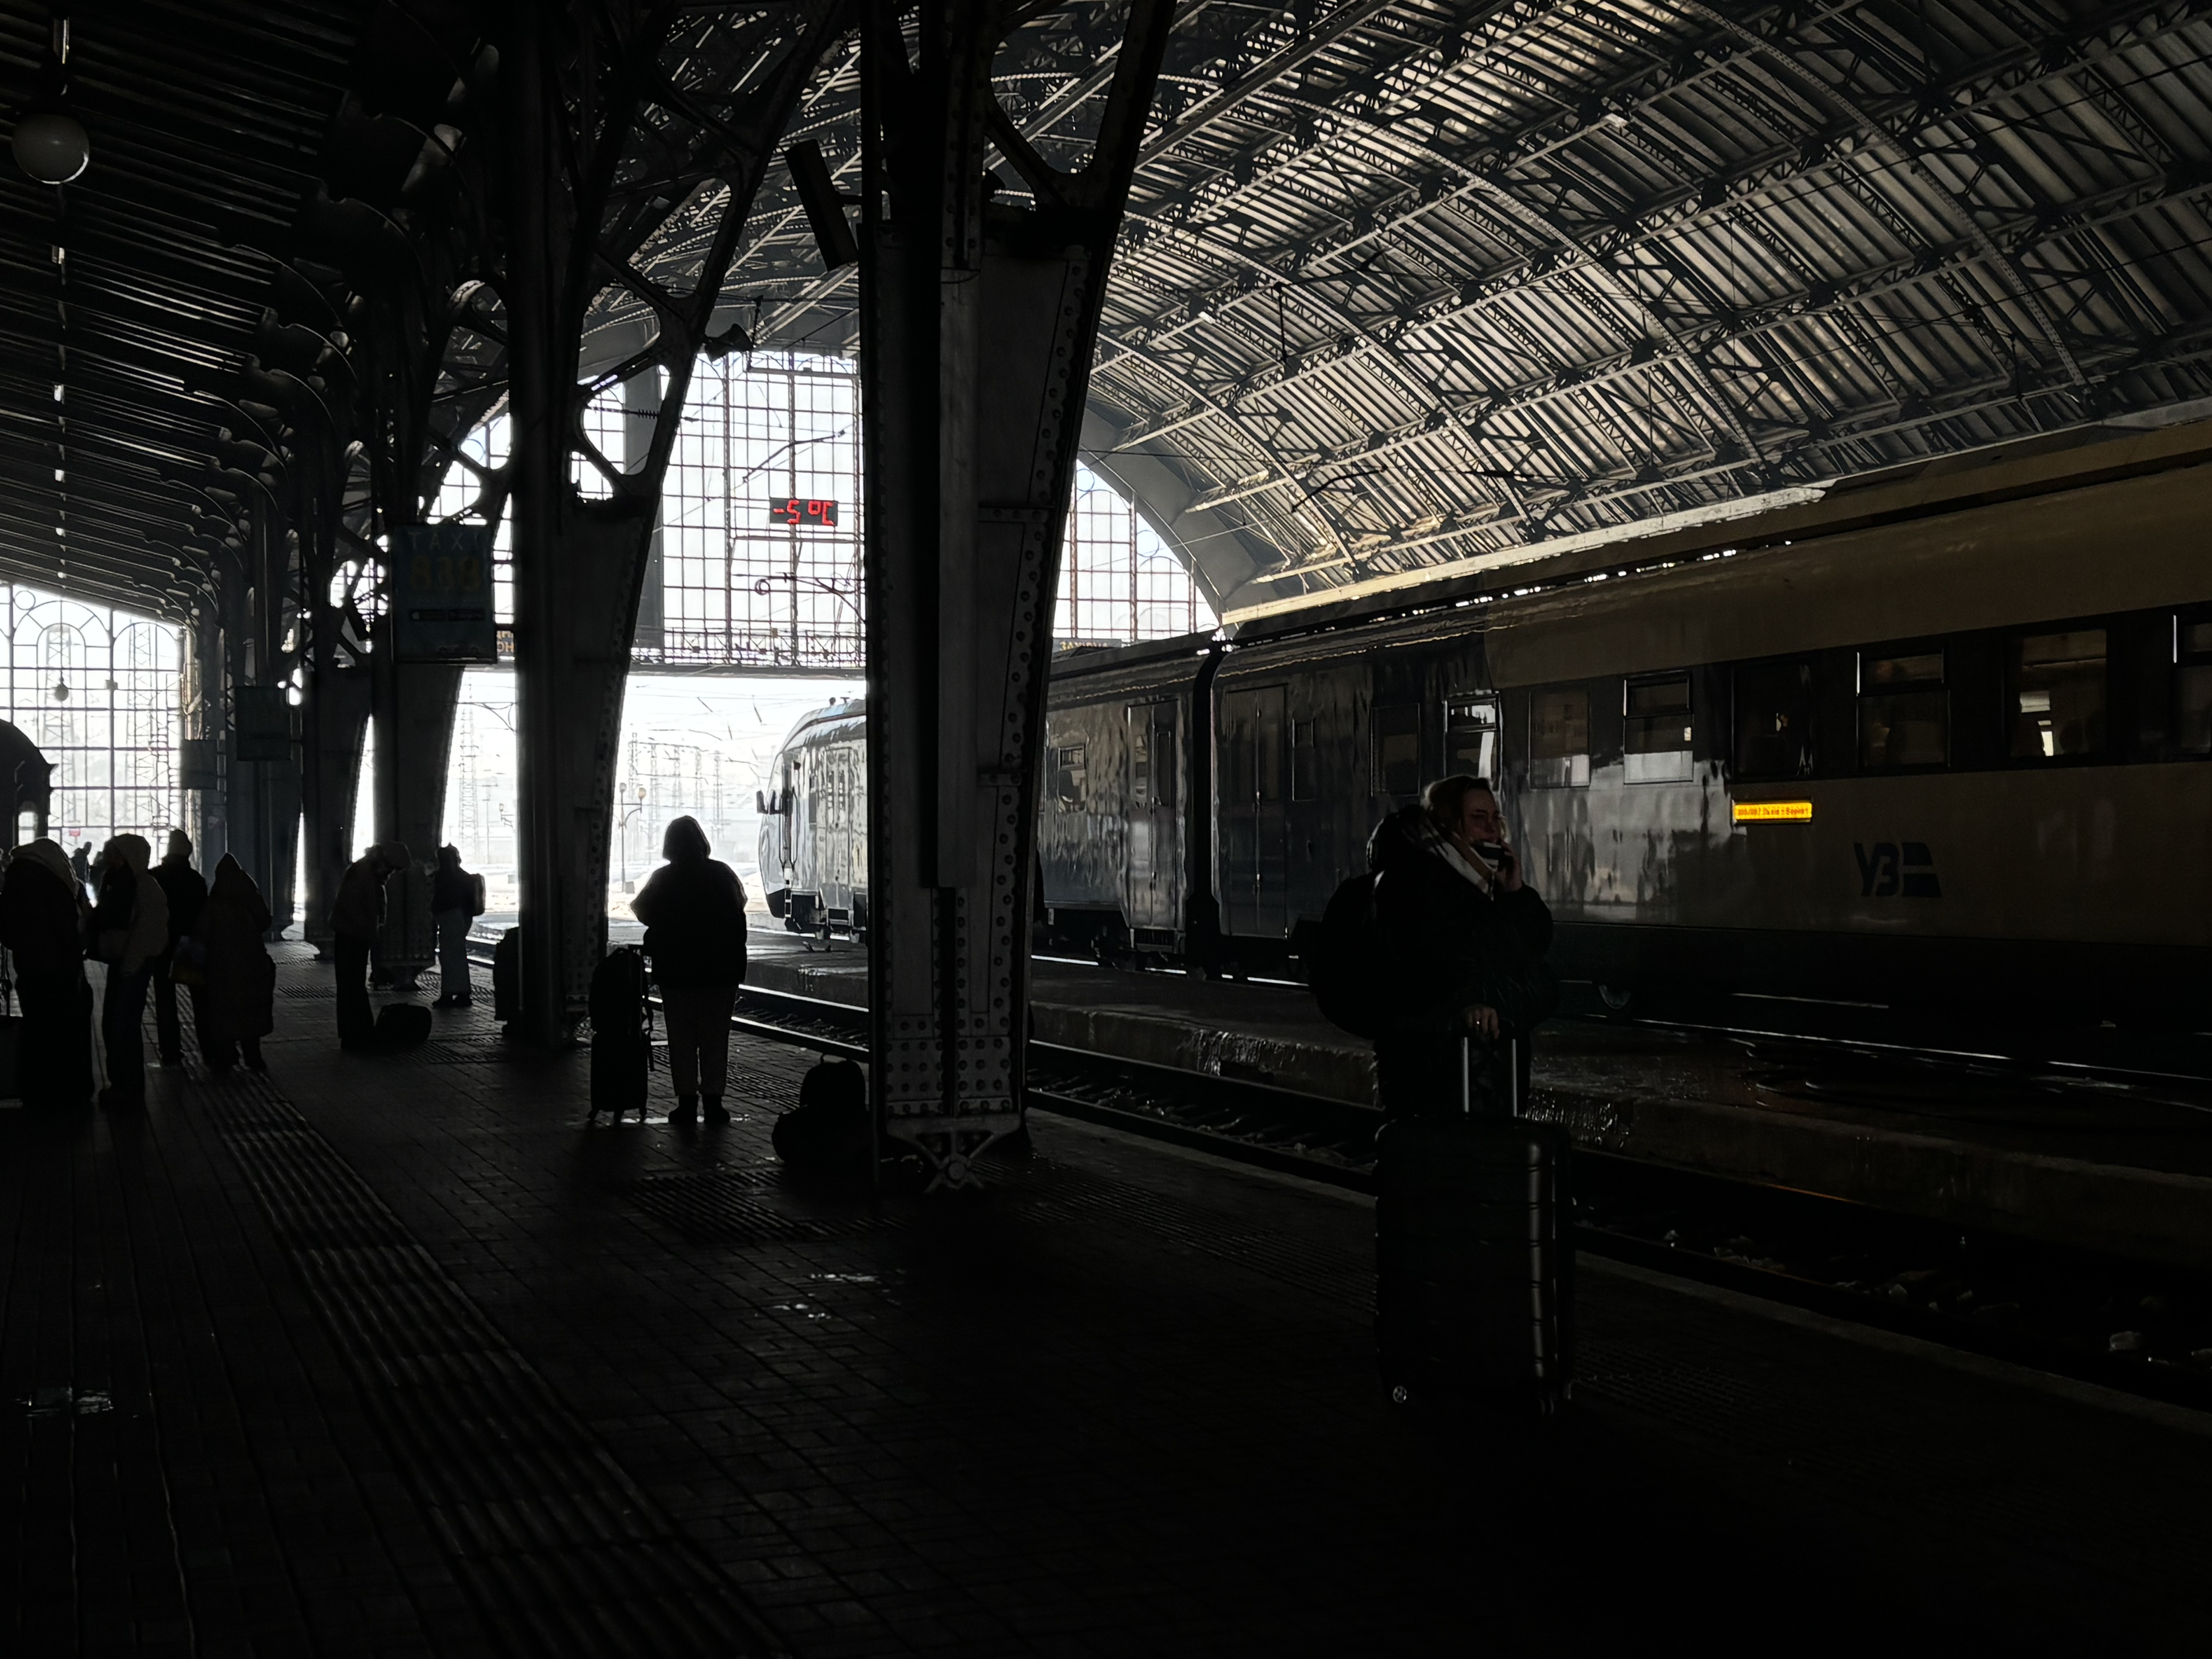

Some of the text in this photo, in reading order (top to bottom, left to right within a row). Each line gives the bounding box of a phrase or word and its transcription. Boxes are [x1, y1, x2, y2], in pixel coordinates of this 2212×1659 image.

[773, 500, 801, 524] -5
[409, 532, 479, 550] TAXI
[411, 555, 481, 591] 838
